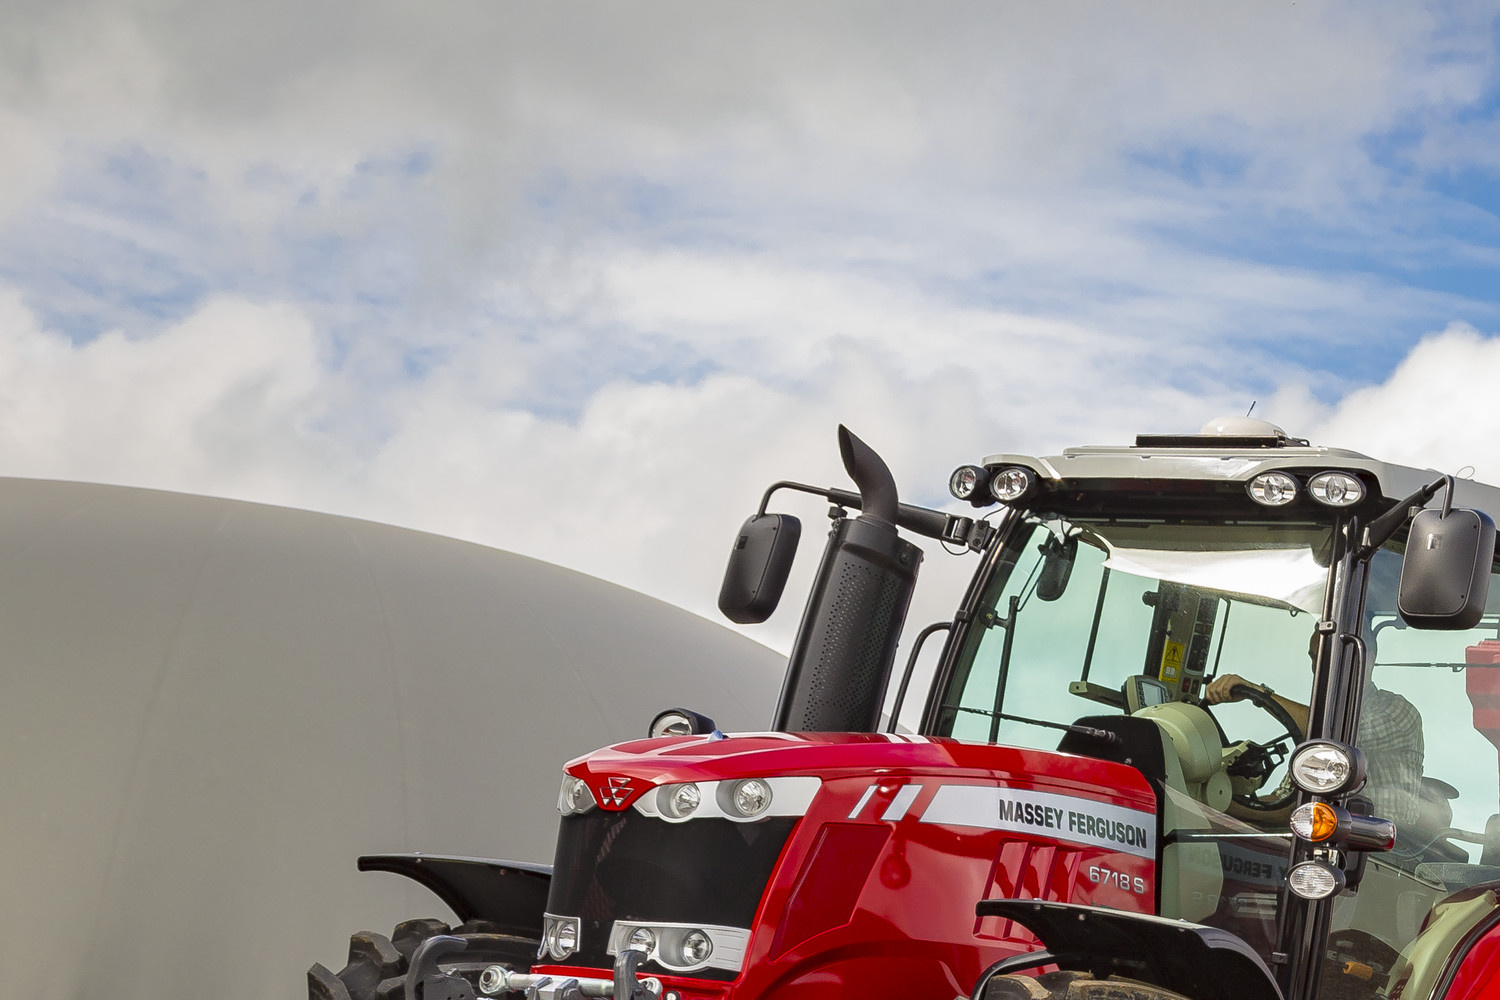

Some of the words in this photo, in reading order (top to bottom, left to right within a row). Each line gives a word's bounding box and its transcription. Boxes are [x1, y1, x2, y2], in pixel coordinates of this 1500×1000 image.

[999, 799, 1064, 829] MASSEY
[1069, 811, 1147, 849] FERGUSON
[1089, 866, 1130, 891] 6718
[1133, 877, 1145, 894] S
